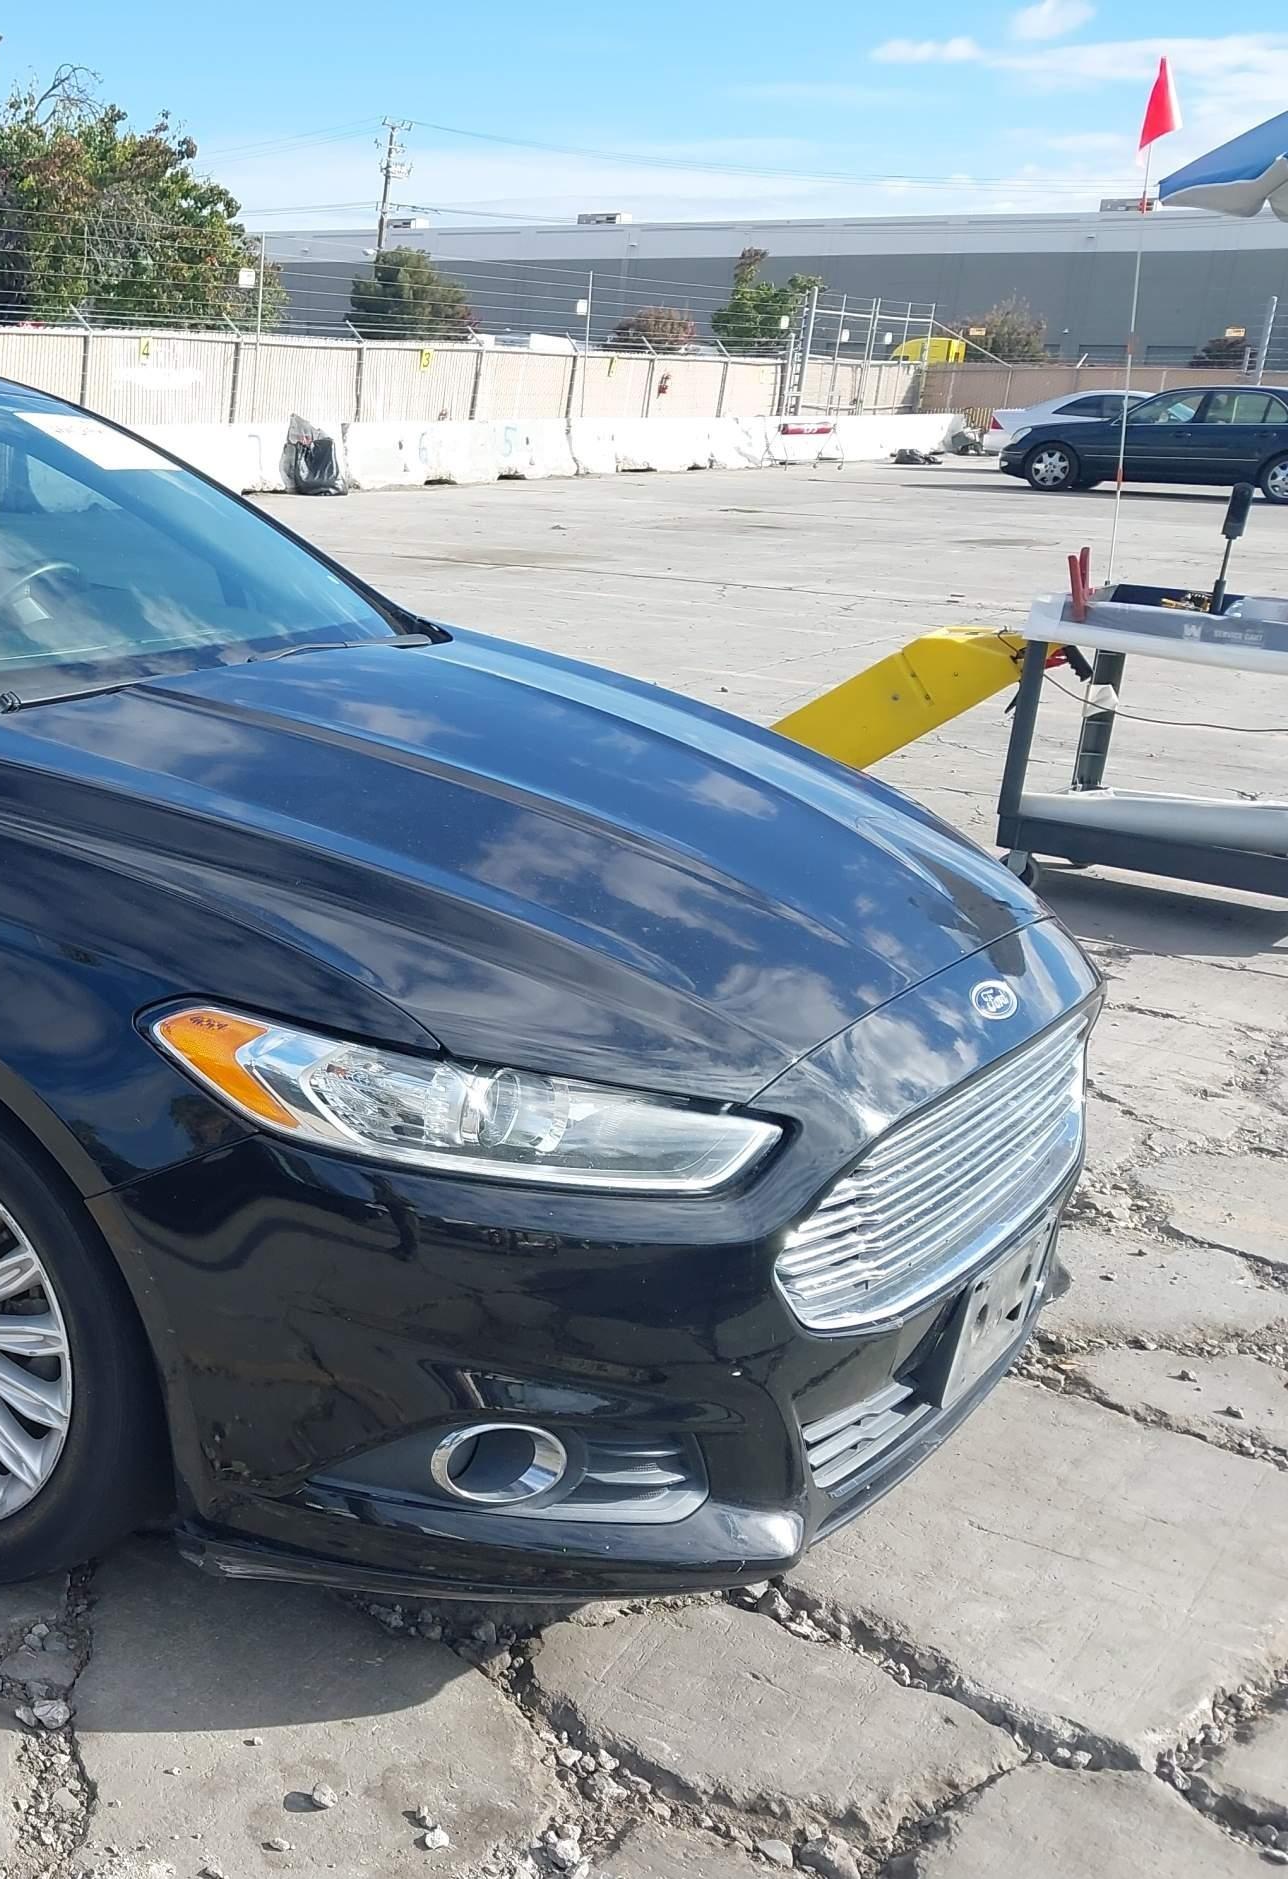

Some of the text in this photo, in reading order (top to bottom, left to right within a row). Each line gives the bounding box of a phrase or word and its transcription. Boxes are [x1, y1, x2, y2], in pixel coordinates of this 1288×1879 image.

[141, 340, 150, 360] 4
[422, 352, 431, 368] 3
[503, 426, 517, 458] 5
